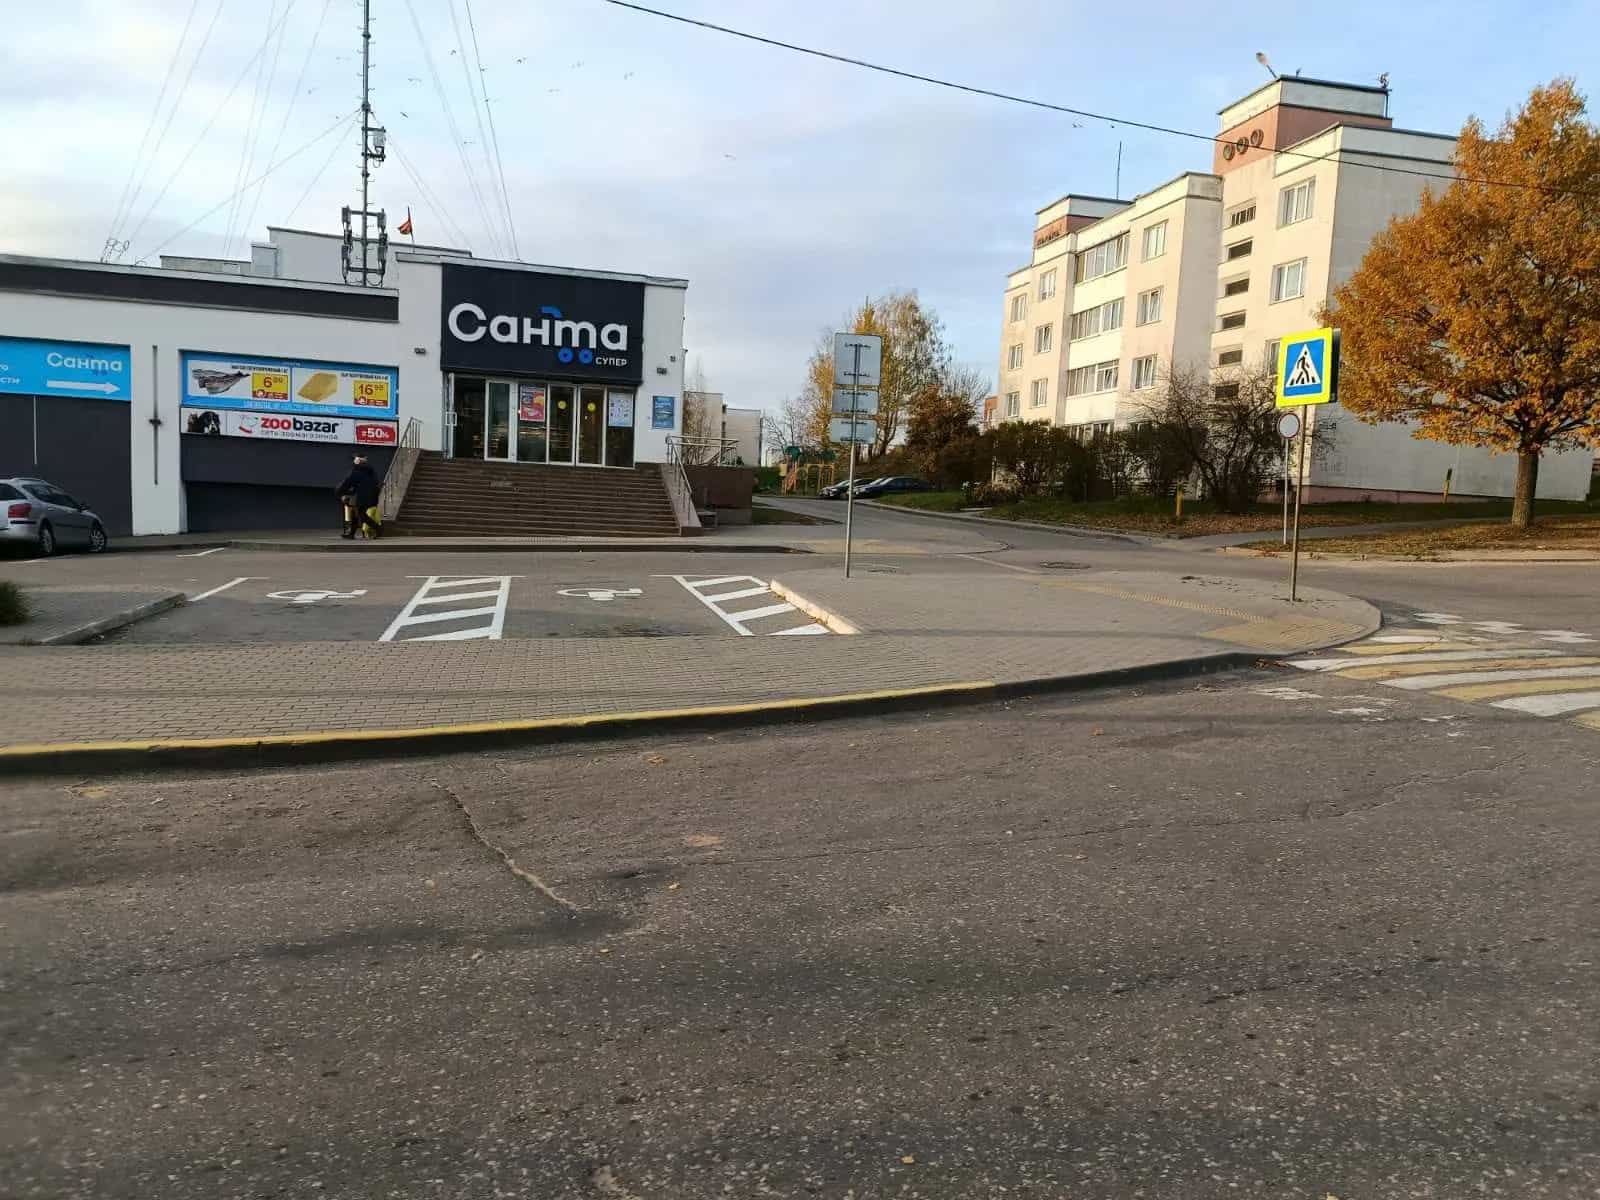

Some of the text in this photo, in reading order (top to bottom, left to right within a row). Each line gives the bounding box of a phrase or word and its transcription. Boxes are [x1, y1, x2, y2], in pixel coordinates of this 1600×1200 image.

[448, 302, 628, 352] Санта
[46, 352, 123, 372] Санта
[595, 356, 628, 367] СУПЕР
[261, 416, 340, 434] zoobazar
